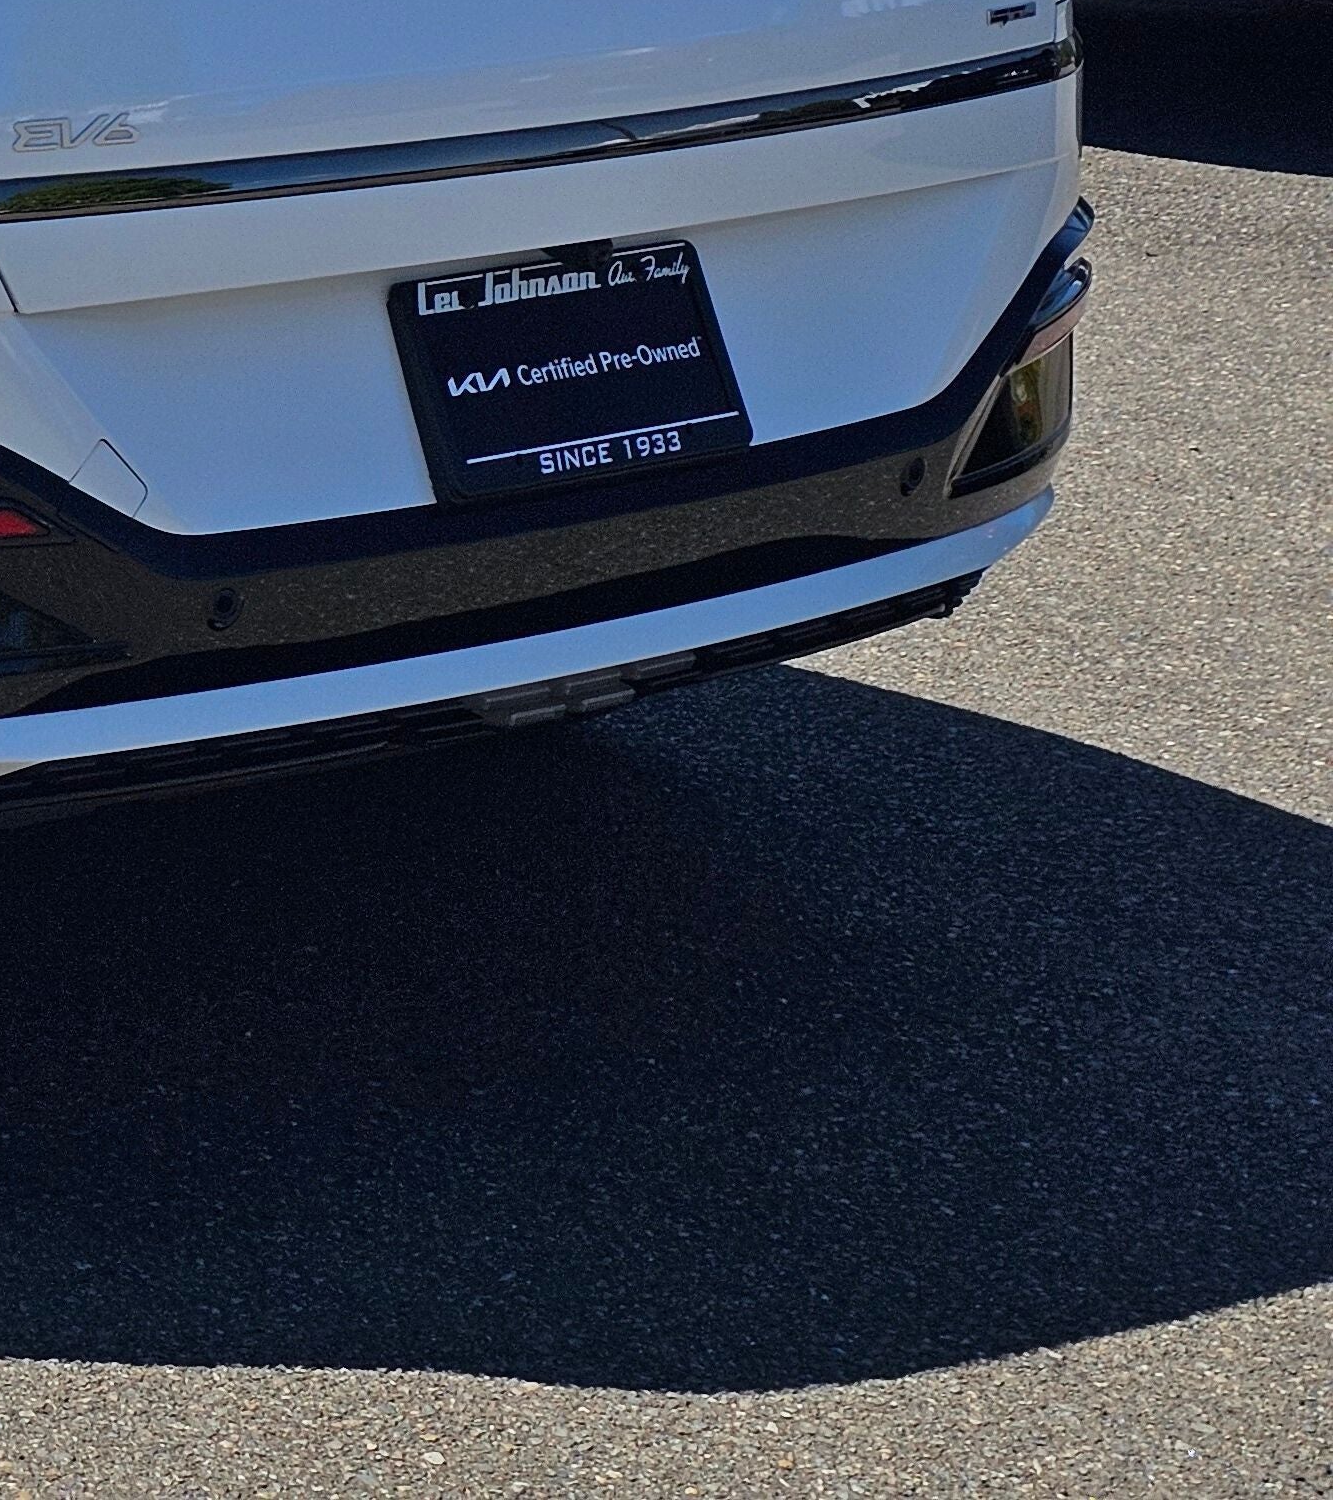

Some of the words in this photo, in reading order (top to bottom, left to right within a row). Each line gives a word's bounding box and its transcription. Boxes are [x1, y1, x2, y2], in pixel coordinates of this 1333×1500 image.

[12, 112, 141, 152] EV6
[478, 267, 602, 307] Johnson
[640, 251, 691, 285] Family
[447, 367, 511, 397] KIA
[516, 353, 599, 386] Certified
[598, 337, 702, 373] Pre-Owned
[539, 443, 614, 474] SINCE
[623, 431, 682, 459] 1933
